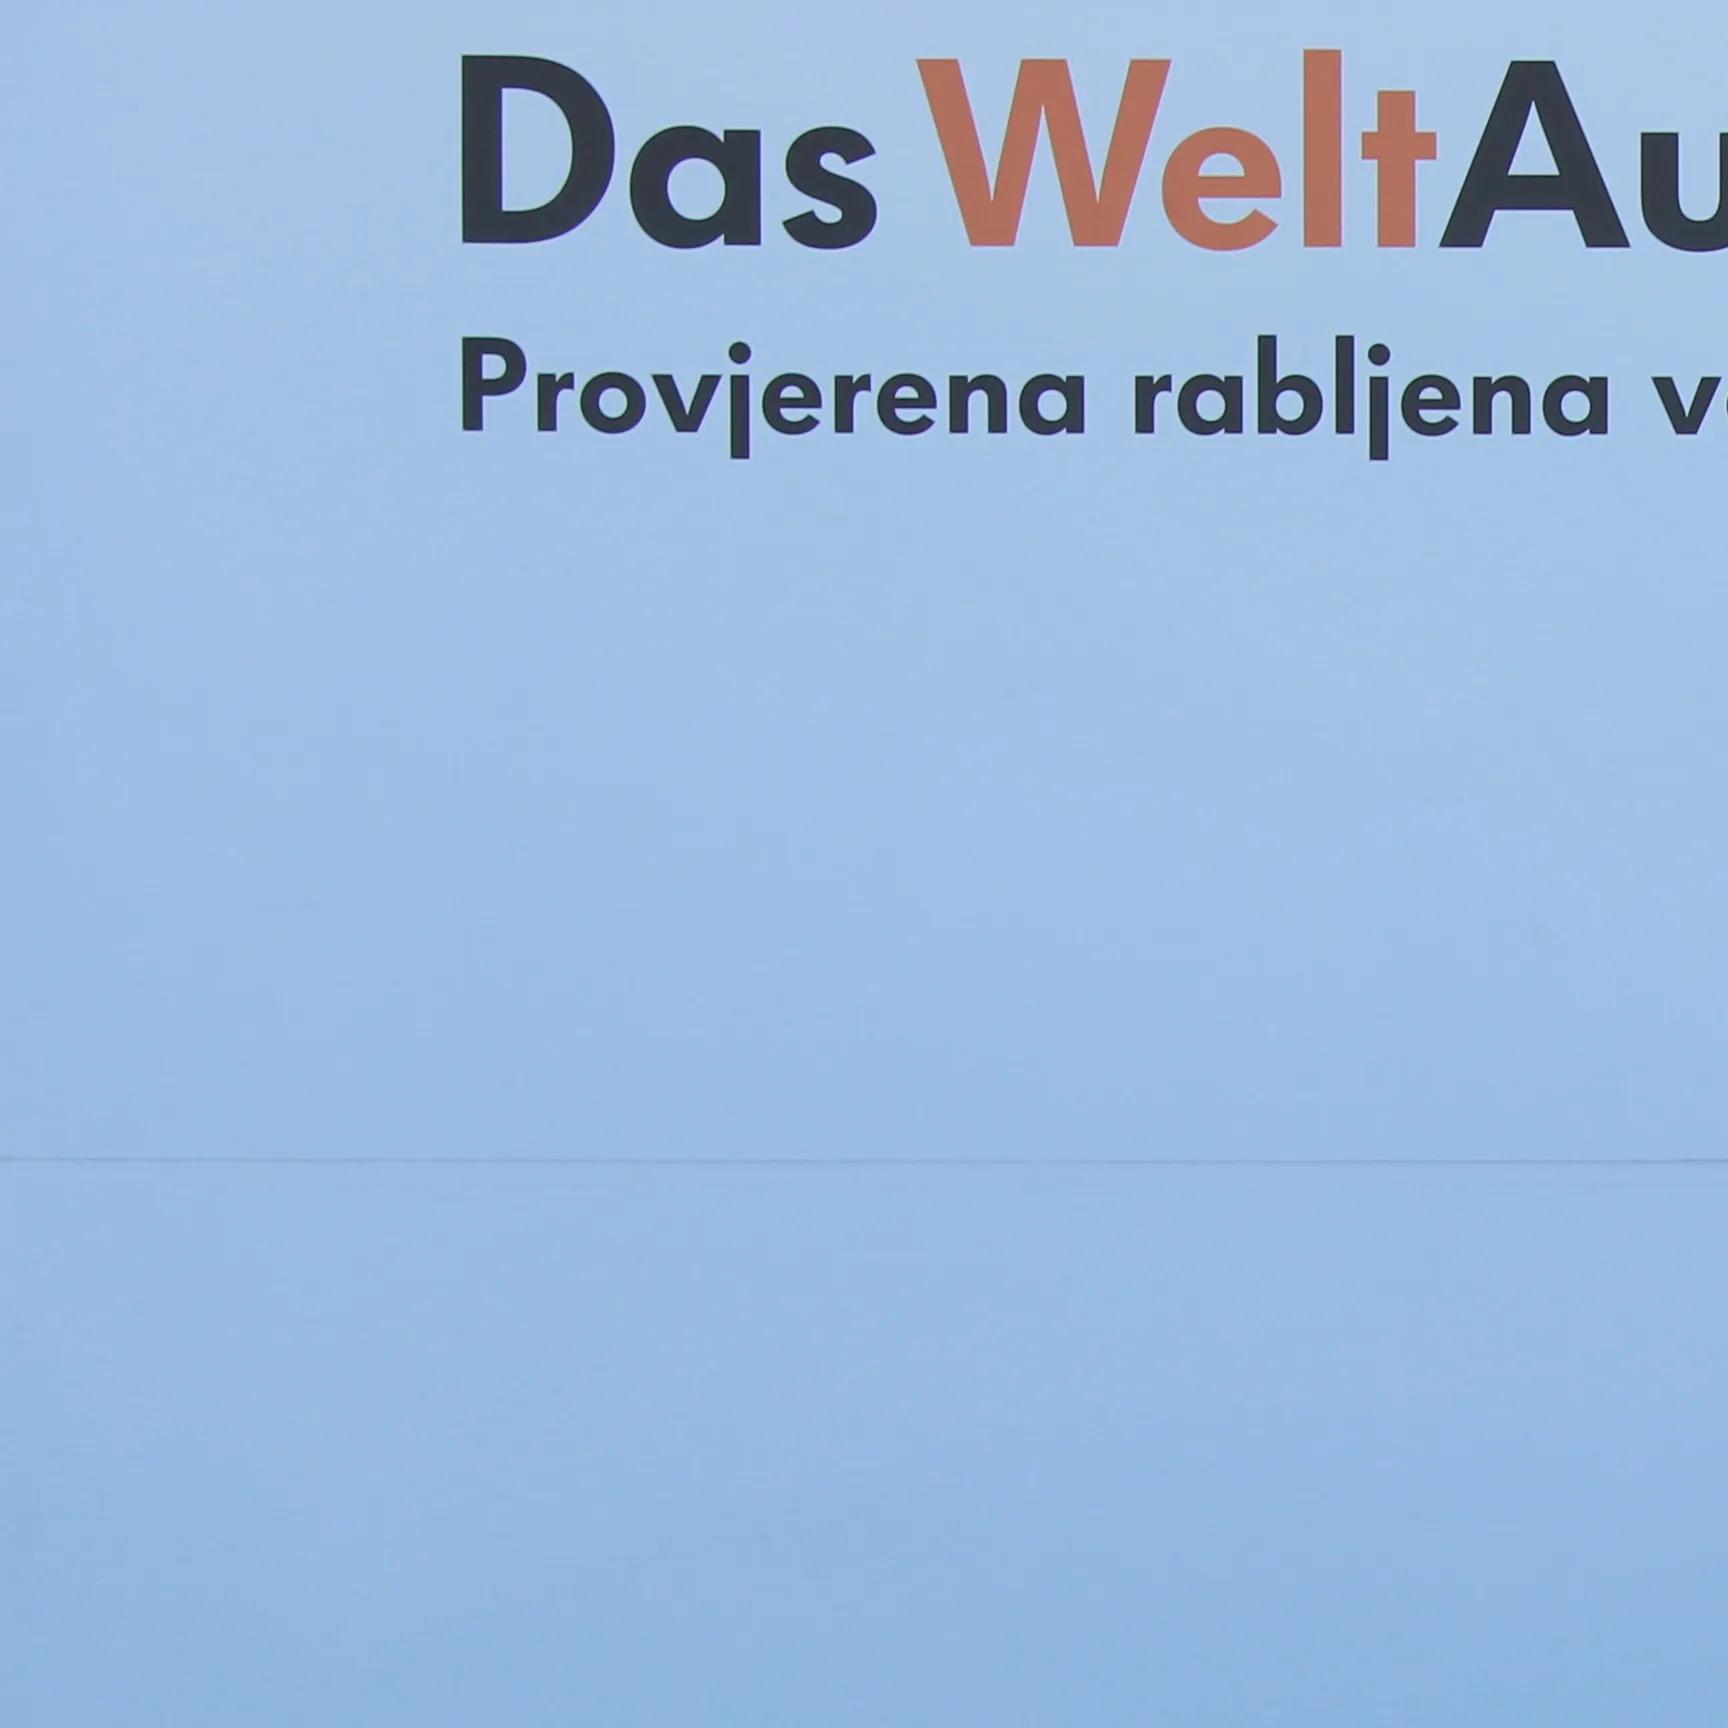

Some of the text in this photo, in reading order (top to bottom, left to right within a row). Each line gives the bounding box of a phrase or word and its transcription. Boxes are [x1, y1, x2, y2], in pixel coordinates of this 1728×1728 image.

[462, 56, 876, 248] Das
[462, 338, 1084, 459] Provjerena
[1135, 335, 1608, 460] rabljena
